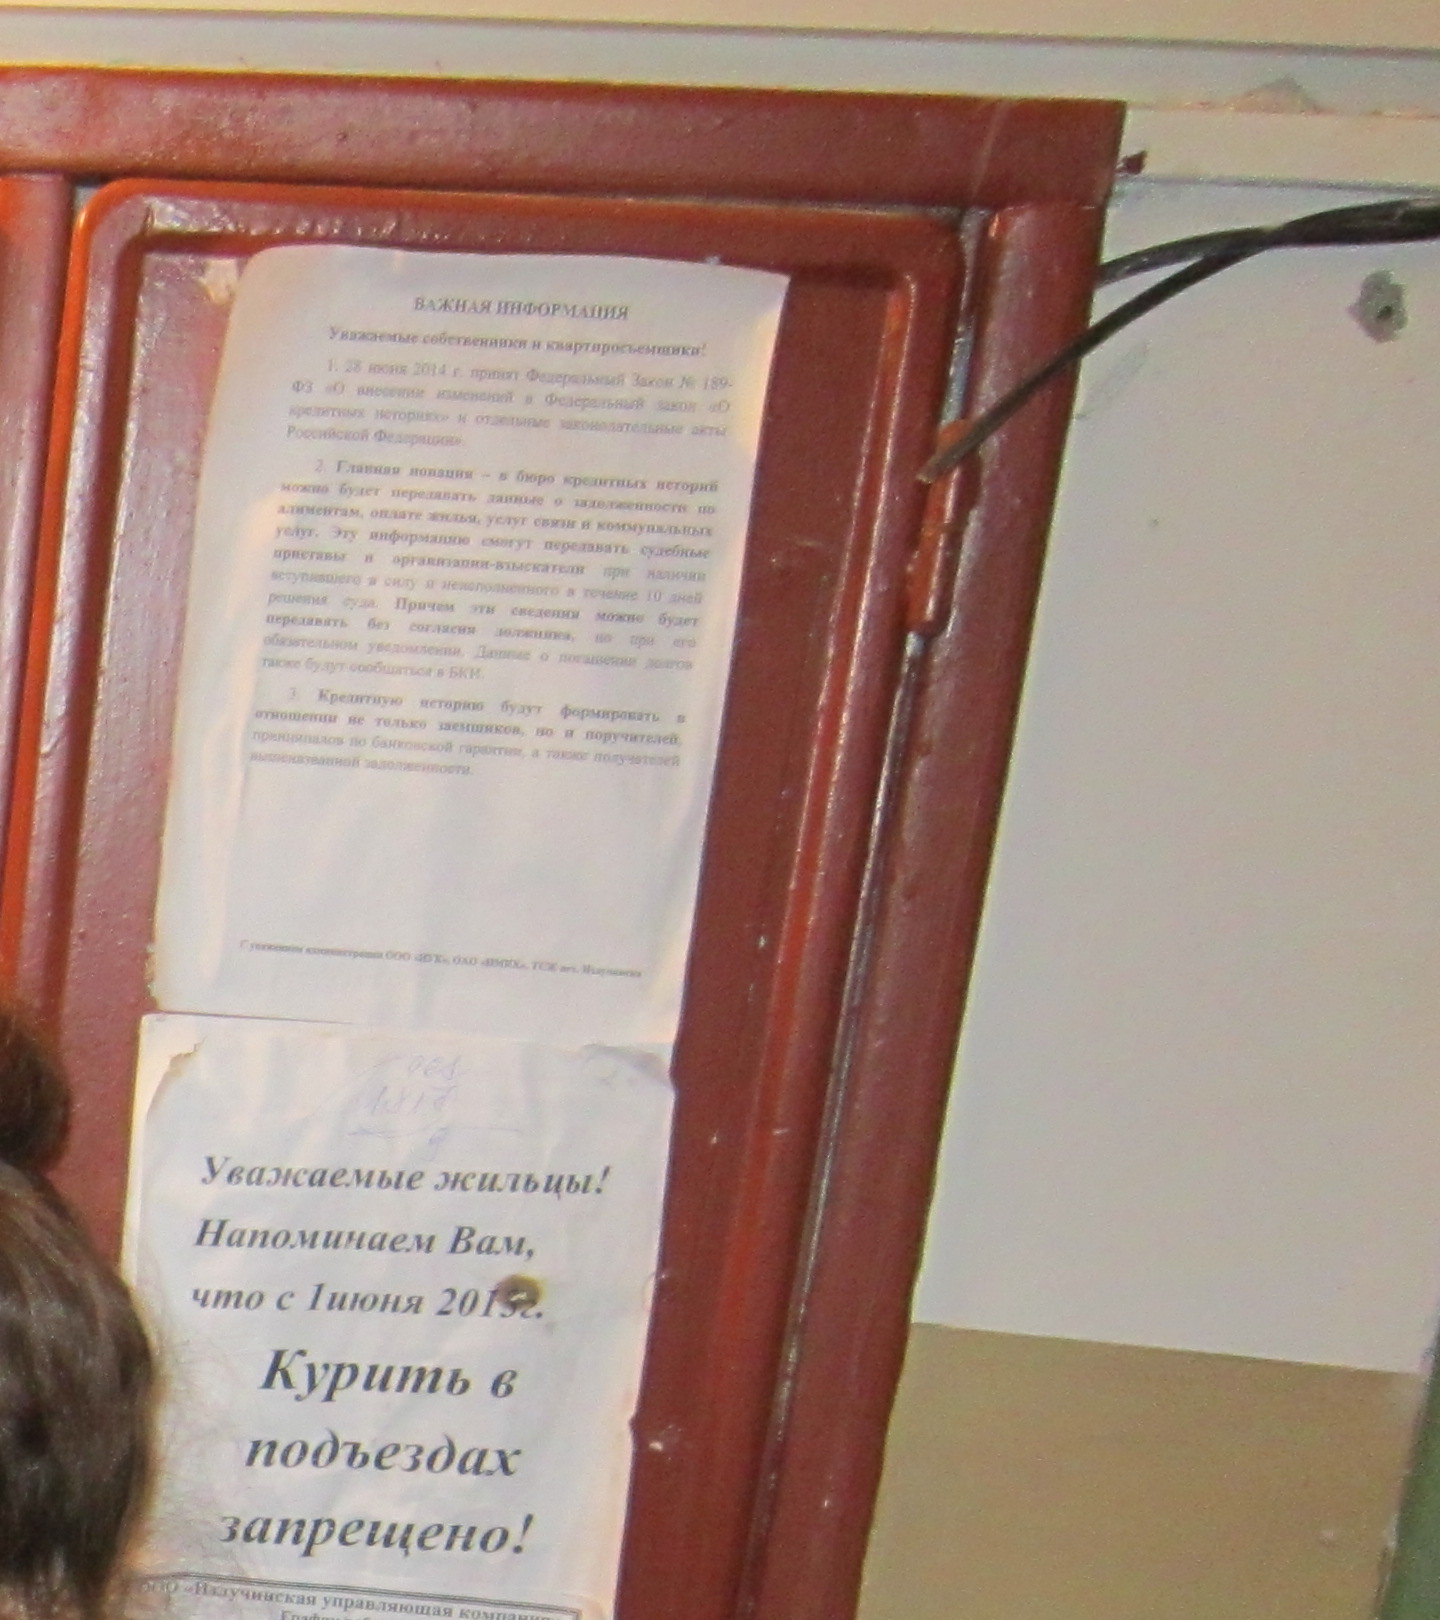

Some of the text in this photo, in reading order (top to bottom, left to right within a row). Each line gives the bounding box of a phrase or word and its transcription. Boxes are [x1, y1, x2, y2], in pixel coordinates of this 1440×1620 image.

[413, 296, 629, 321] ВАЖНАЯ ИНФОРМАЦИЯ
[328, 325, 707, 358] Уважаемые собственники квартиросъемщики!
[525, 368, 625, 389] Федеральный
[280, 482, 330, 495] можно
[390, 488, 477, 503] передавать
[336, 460, 401, 476] Главная
[516, 469, 555, 486] бюро
[563, 475, 647, 491] кредитных
[655, 479, 719, 496] историй
[533, 516, 576, 531] связи
[596, 521, 713, 538] коммунальных
[272, 547, 348, 565] приставы
[369, 529, 711, 560] информацию передавать судебные
[265, 613, 477, 636] передавать без согласия
[394, 596, 456, 614] Причем
[510, 605, 581, 620] сведения
[595, 610, 645, 624] можно
[254, 709, 338, 725] отношении
[375, 716, 427, 730] только
[318, 688, 404, 708] Кредитную
[419, 698, 485, 713] историю
[559, 702, 660, 722] формировать
[201, 1155, 612, 1200] Уважаемые жильцы!
[193, 1218, 536, 1262] Напоминаем Вам,
[191, 1284, 265, 1312] что
[275, 1290, 295, 1312] с
[306, 1282, 423, 1316] 1июня
[260, 1348, 519, 1401] Курить в
[245, 1428, 523, 1477] подъездах
[219, 1513, 536, 1559] запрещено!
[184, 1580, 317, 1607] «Излучинская
[321, 1593, 453, 1619] управляющая
